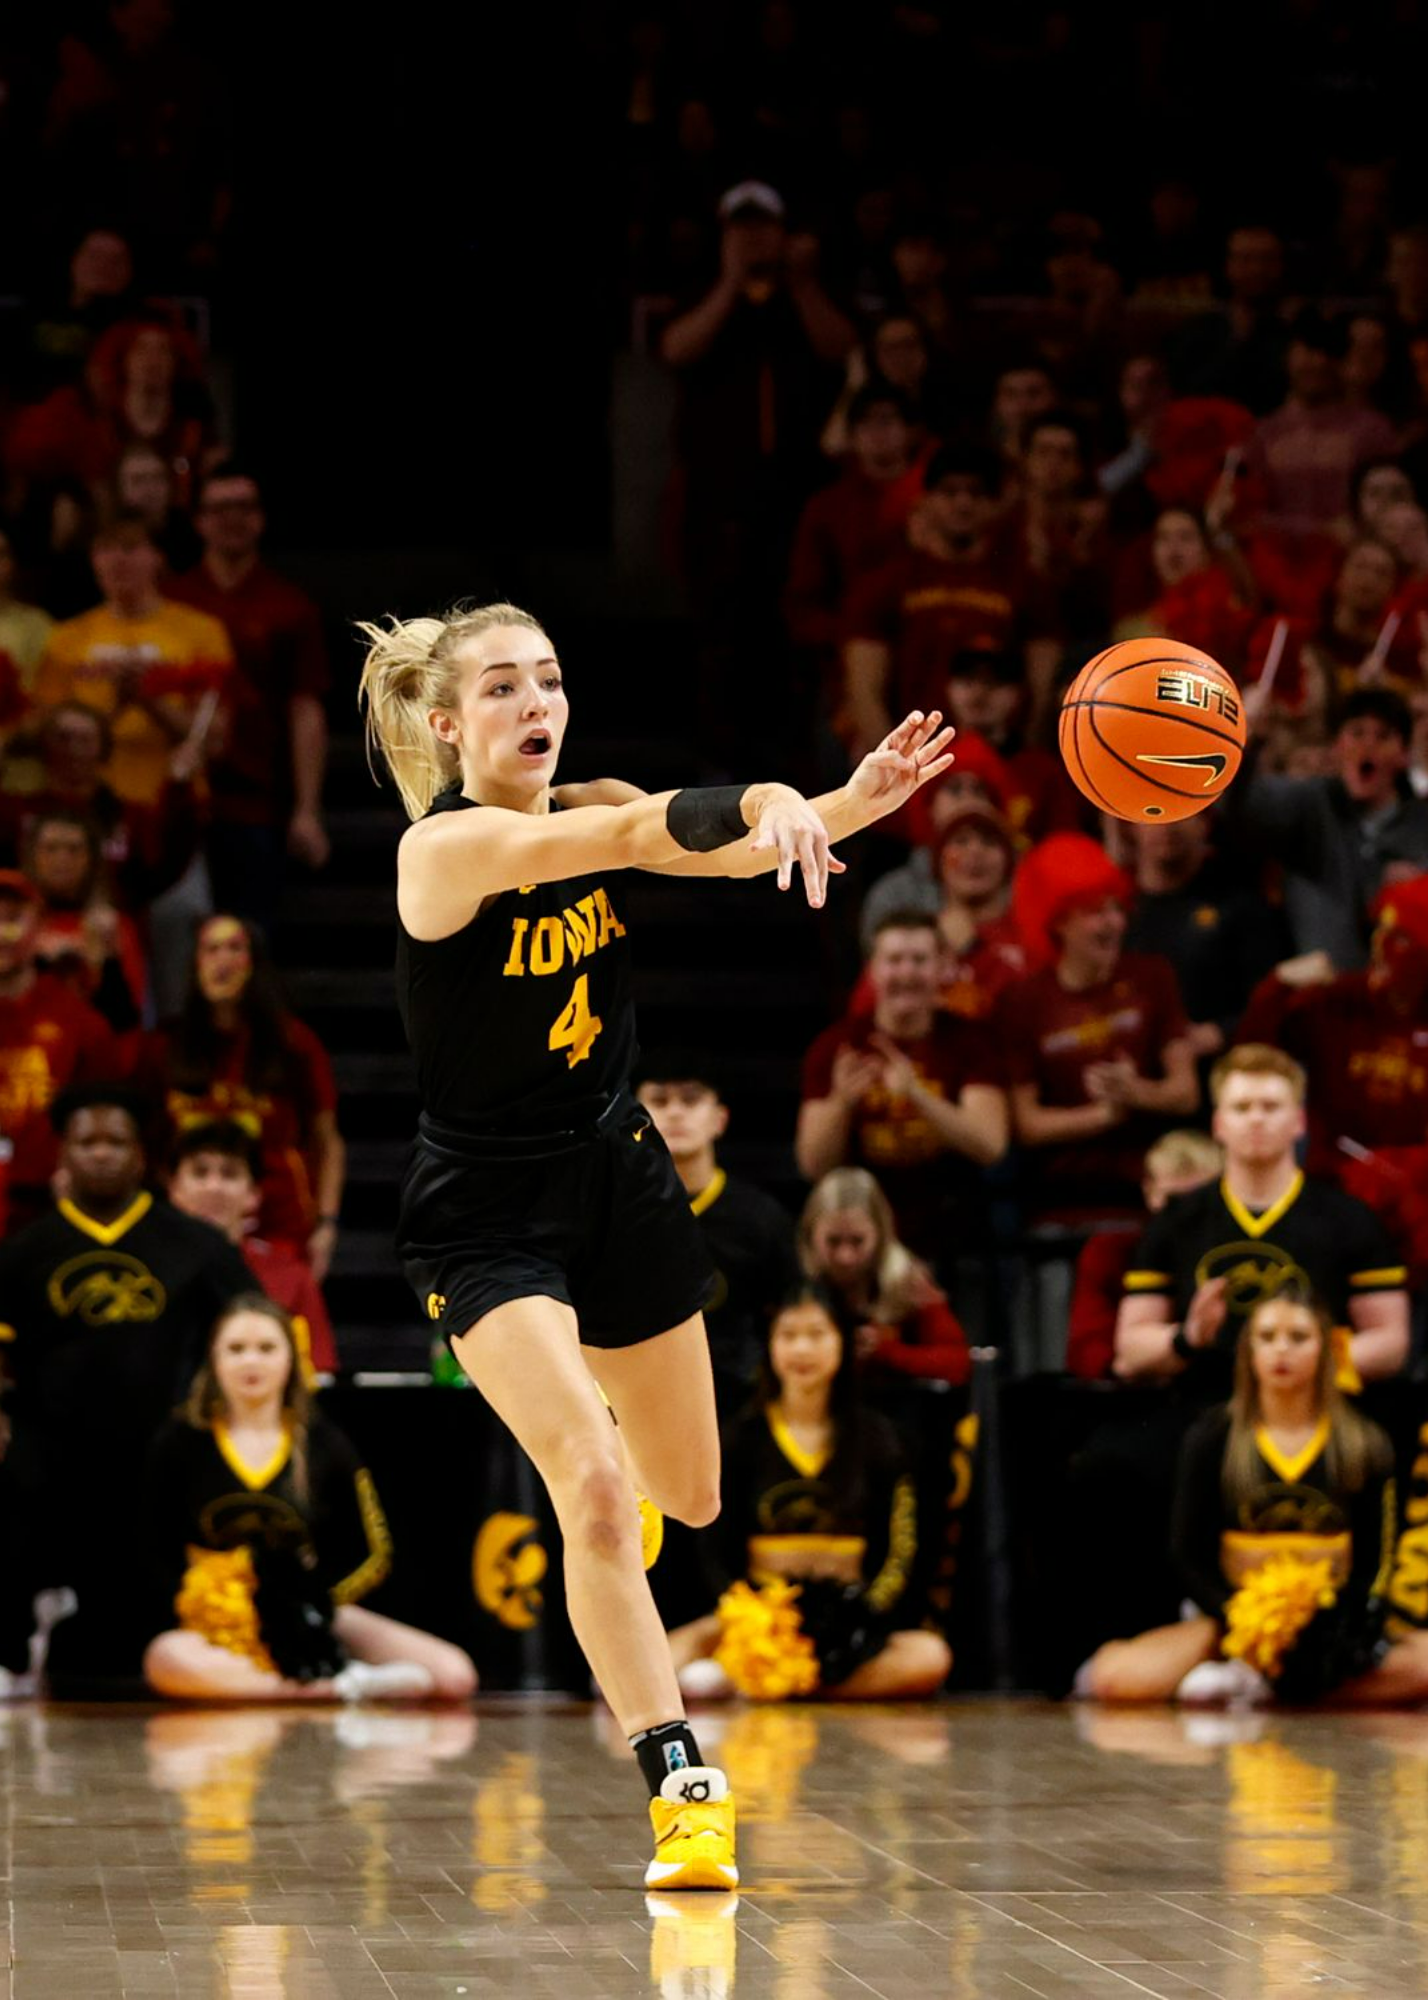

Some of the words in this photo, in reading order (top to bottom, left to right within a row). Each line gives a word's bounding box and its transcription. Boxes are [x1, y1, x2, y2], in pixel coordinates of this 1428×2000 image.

[1156, 677, 1238, 726] ELITE
[503, 887, 626, 976] IOWA
[548, 973, 603, 1070] 4
